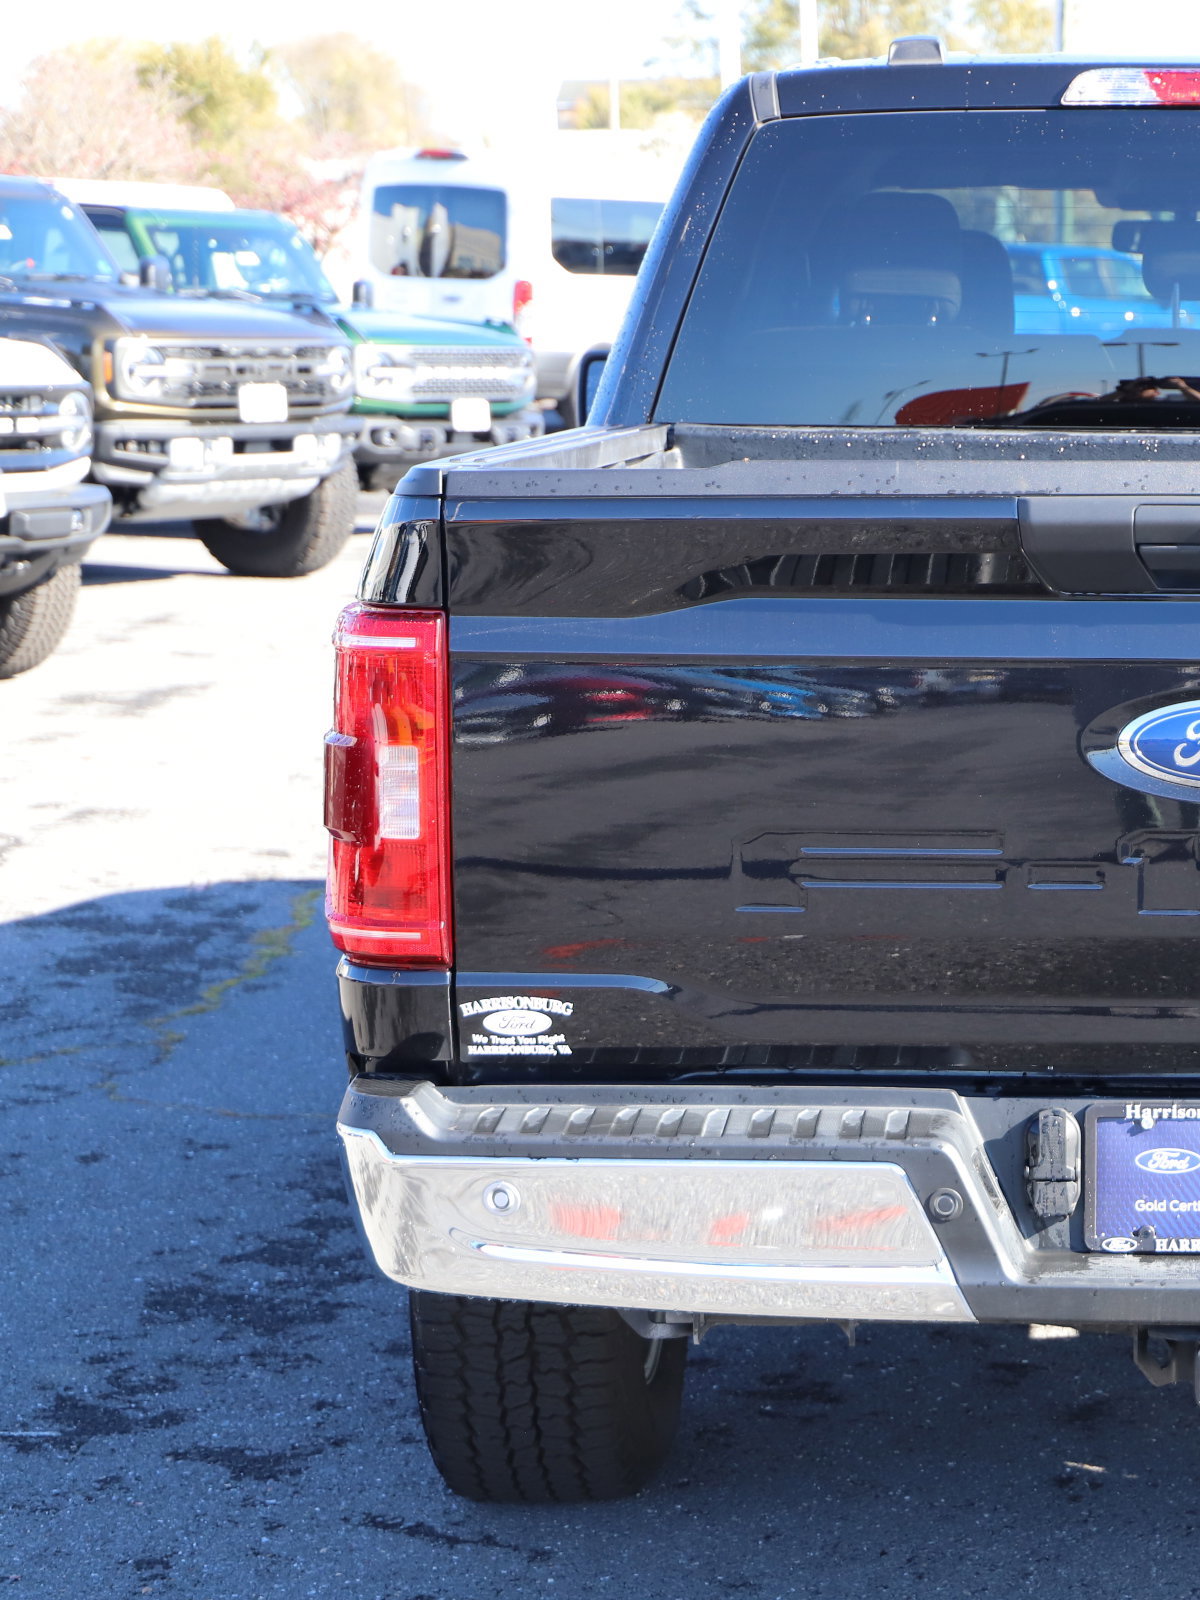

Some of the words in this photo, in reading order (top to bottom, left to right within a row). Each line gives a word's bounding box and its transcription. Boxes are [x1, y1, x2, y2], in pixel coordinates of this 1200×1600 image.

[459, 996, 574, 1017] HARRISONBURG
[498, 1015, 536, 1029] Ford
[1147, 1151, 1189, 1169] Ford
[1134, 1200, 1166, 1212] Gold
